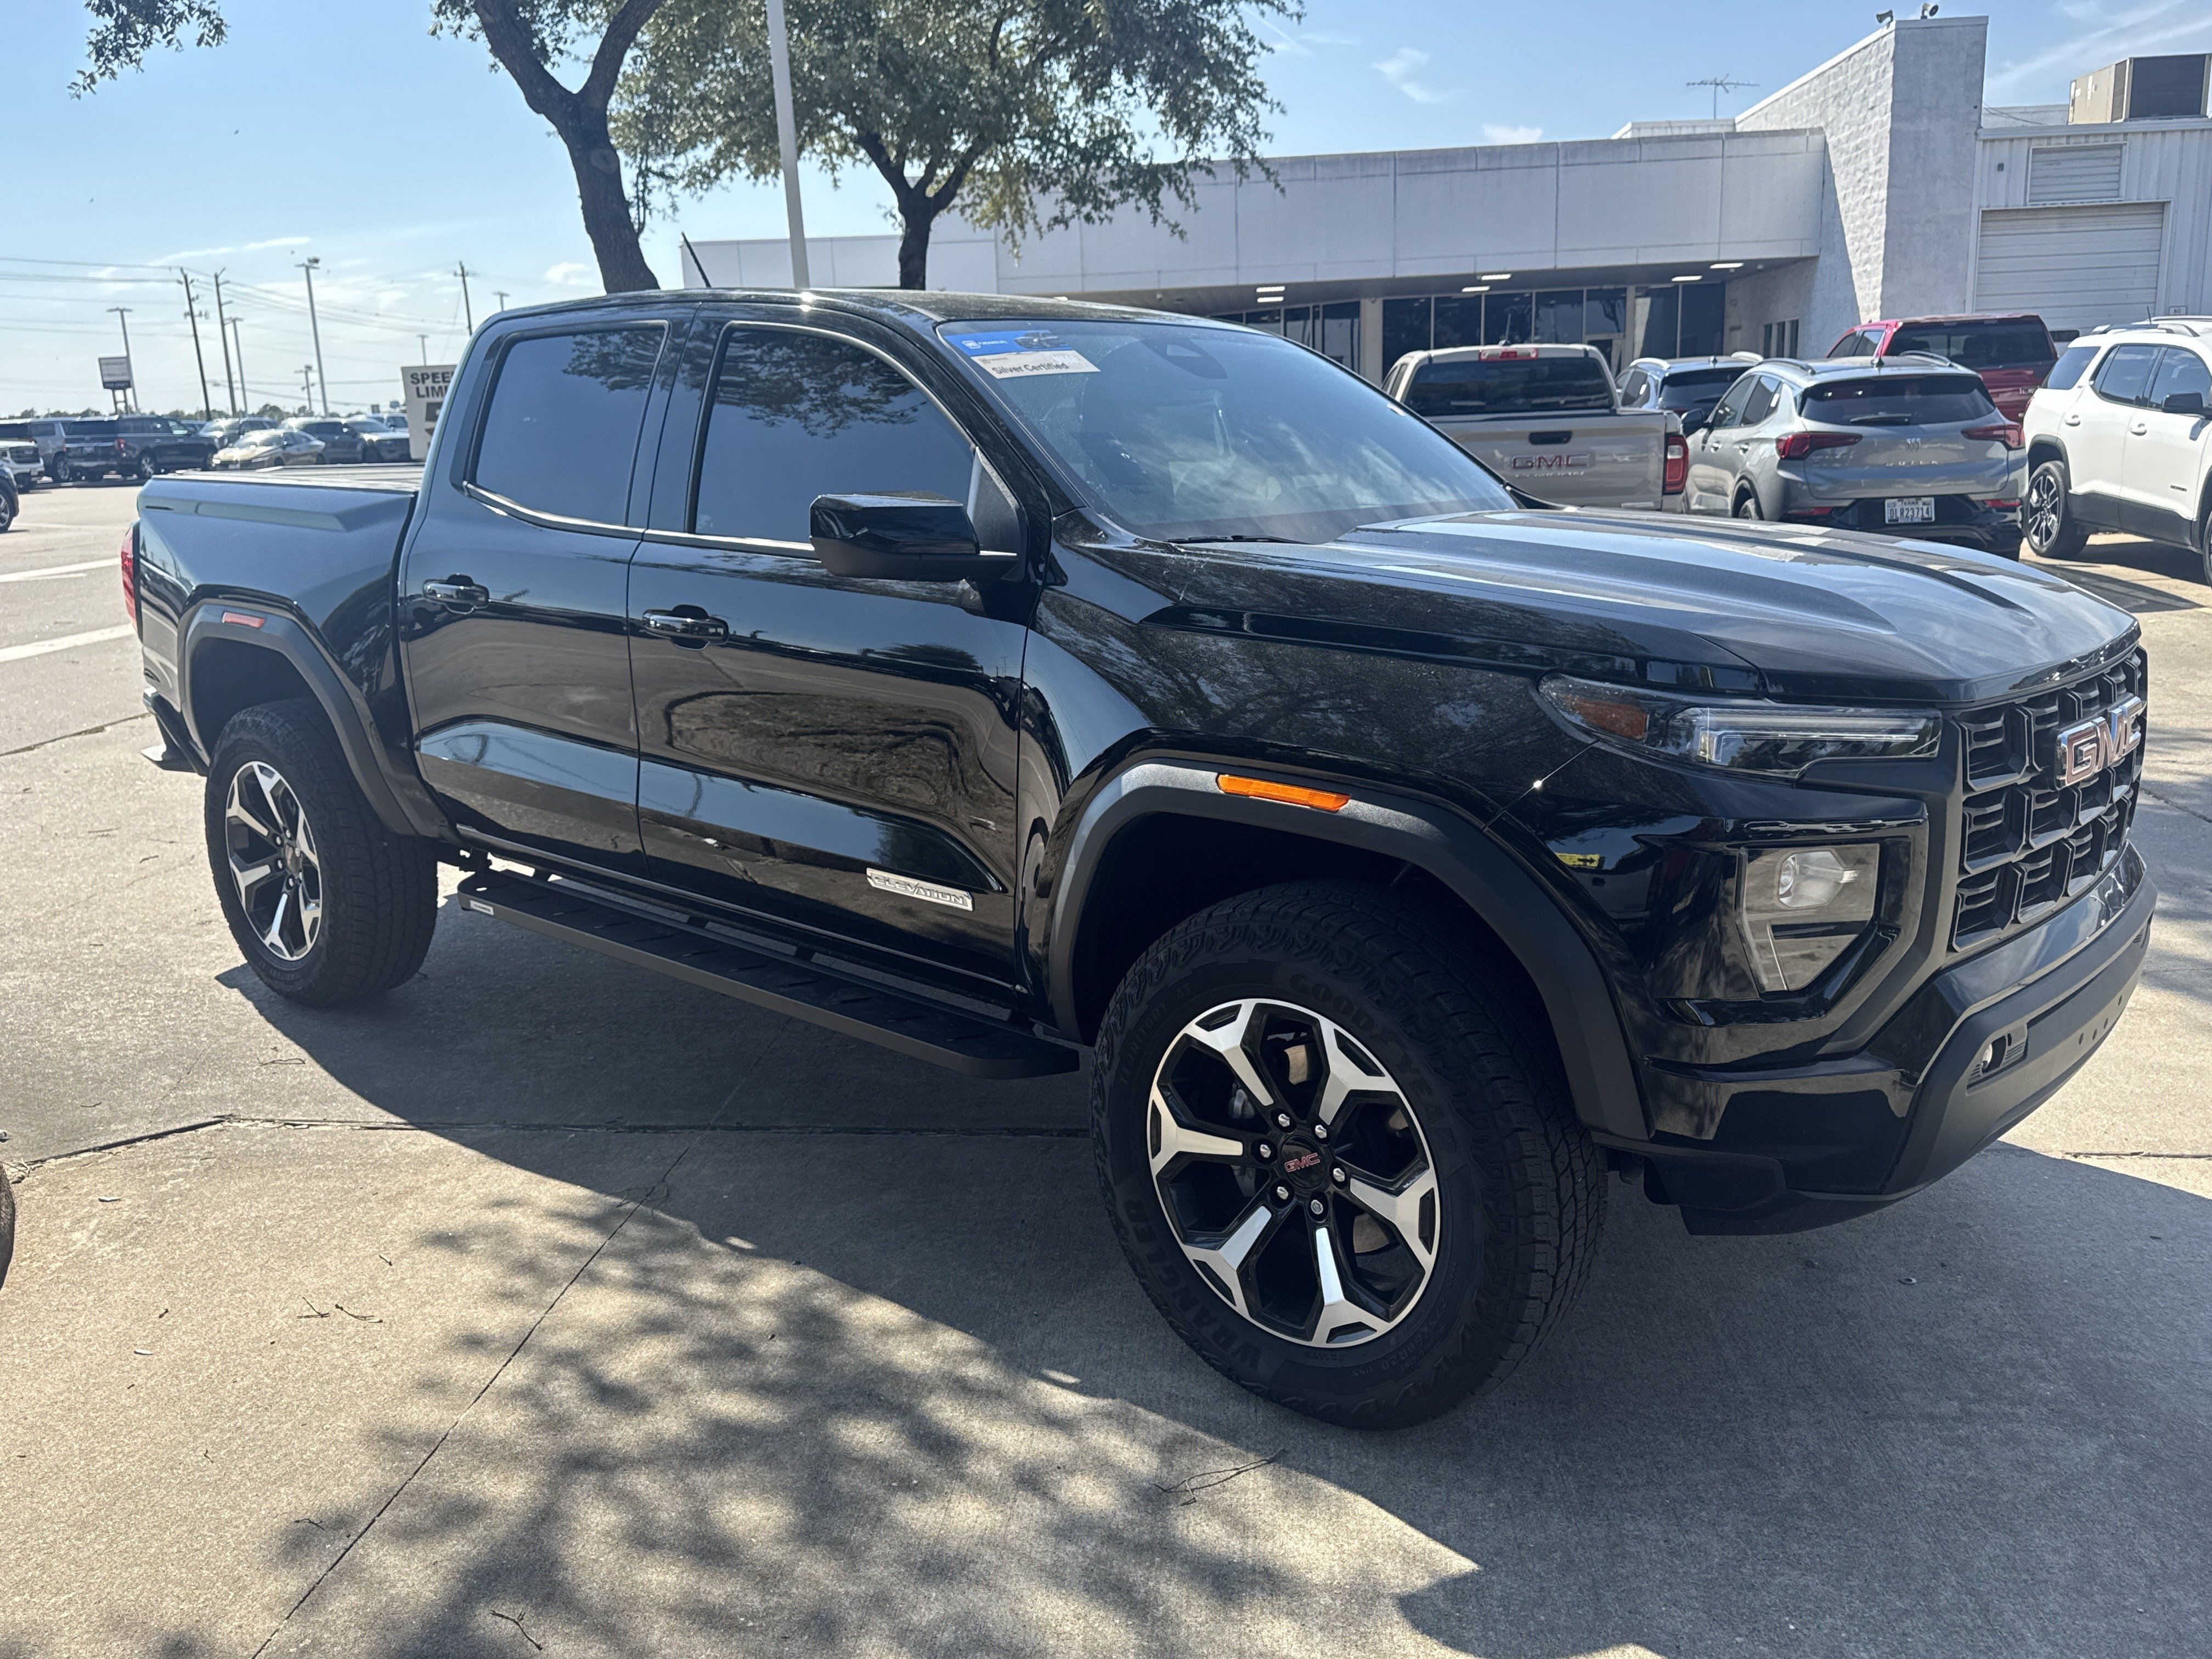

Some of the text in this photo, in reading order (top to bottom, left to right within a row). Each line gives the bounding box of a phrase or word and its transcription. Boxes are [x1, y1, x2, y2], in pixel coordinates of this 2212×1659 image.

[411, 371, 454, 385] SPEE
[992, 362, 1069, 374] Silver Certified
[416, 386, 448, 398] LIM
[1511, 453, 1590, 470] GMC
[2056, 696, 2143, 791] GMC
[873, 875, 965, 905] ELEVATION
[1120, 981, 1192, 1084] TERRITORY AT
[1289, 973, 1458, 1154] GOODYEAR
[1284, 1153, 1321, 1172] GMC
[1122, 1200, 1262, 1369] WRANGLER
